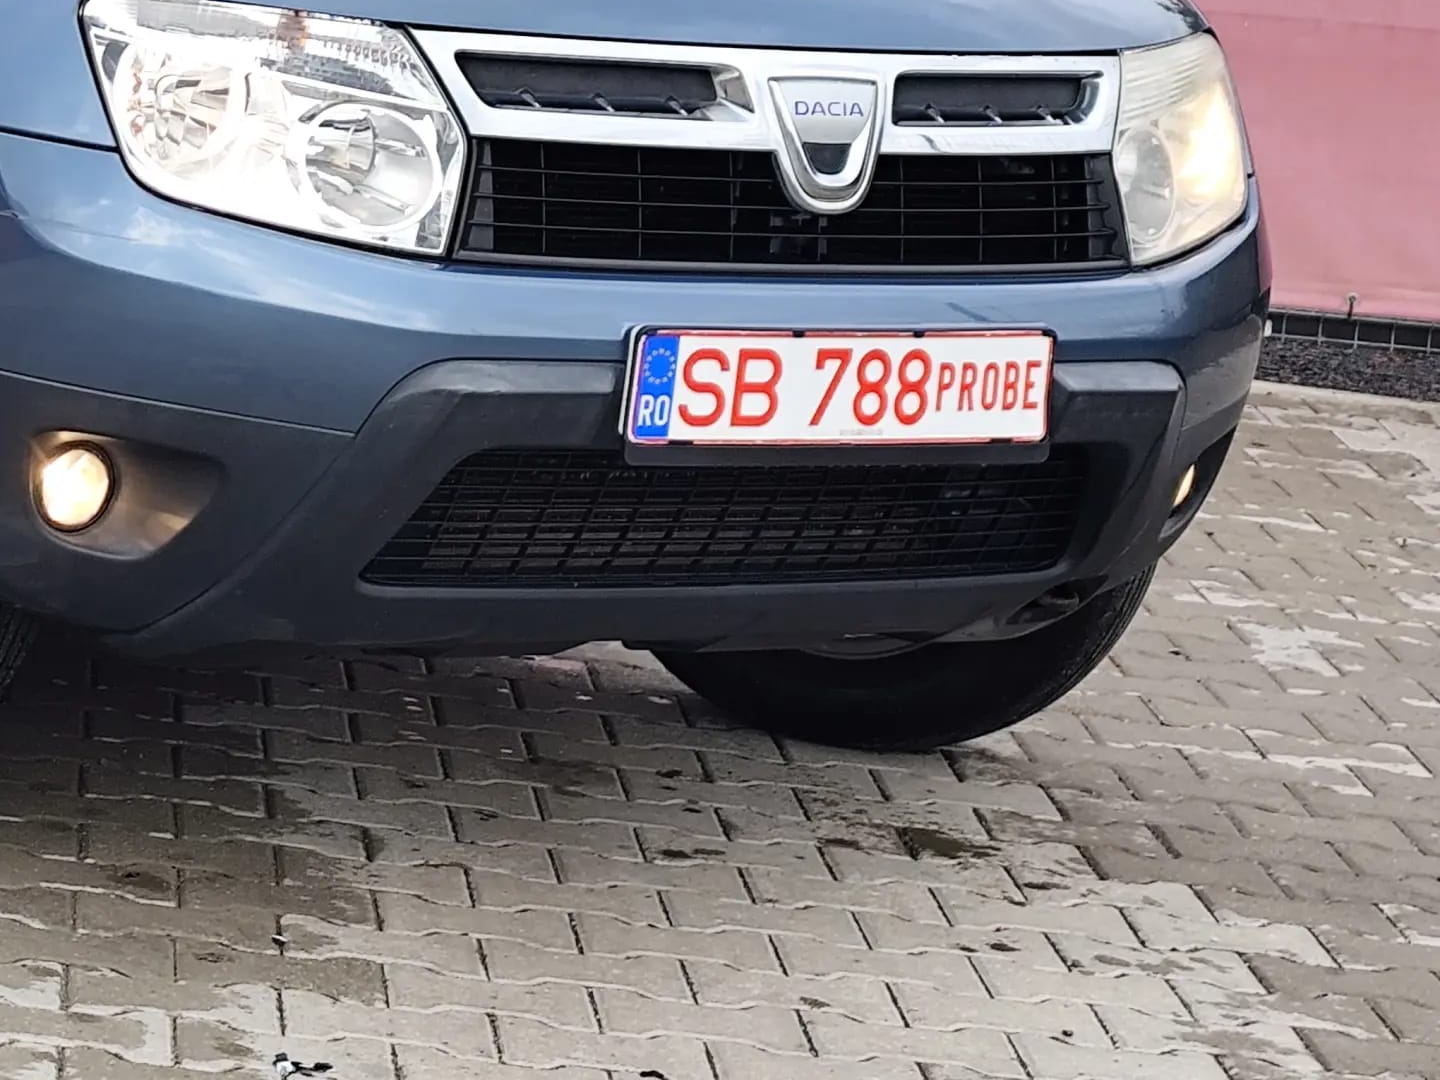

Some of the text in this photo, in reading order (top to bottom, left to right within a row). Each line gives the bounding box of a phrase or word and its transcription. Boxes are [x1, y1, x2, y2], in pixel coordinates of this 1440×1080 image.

[794, 100, 865, 117] DACIA
[678, 348, 1042, 427] SB 788 PROBE
[637, 395, 671, 427] RO
